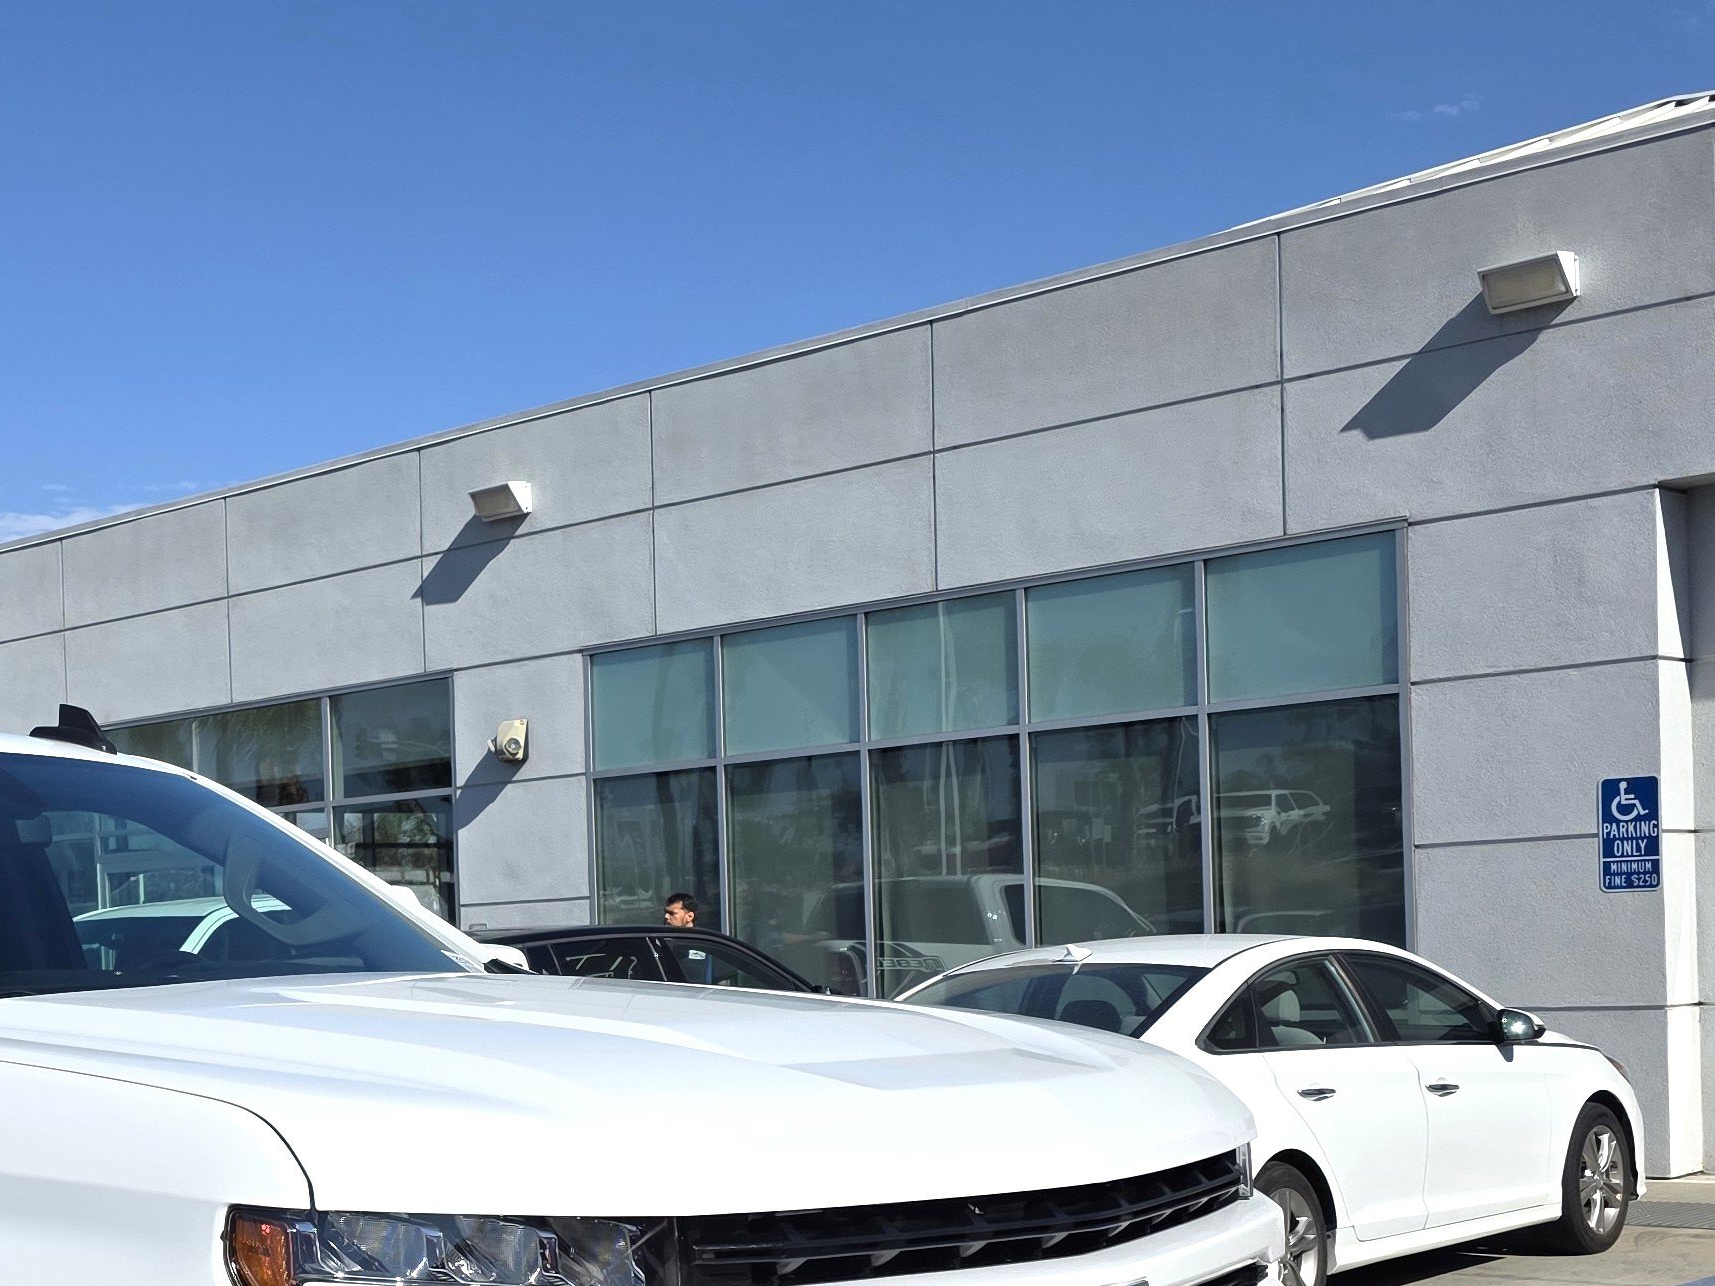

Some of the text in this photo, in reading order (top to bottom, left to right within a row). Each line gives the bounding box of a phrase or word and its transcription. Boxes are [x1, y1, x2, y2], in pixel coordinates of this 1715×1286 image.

[1604, 820, 1658, 838] PARKING
[1614, 839, 1648, 856] ONLY
[1610, 861, 1652, 873] MINIMUM
[1605, 873, 1658, 887] FINE $250
